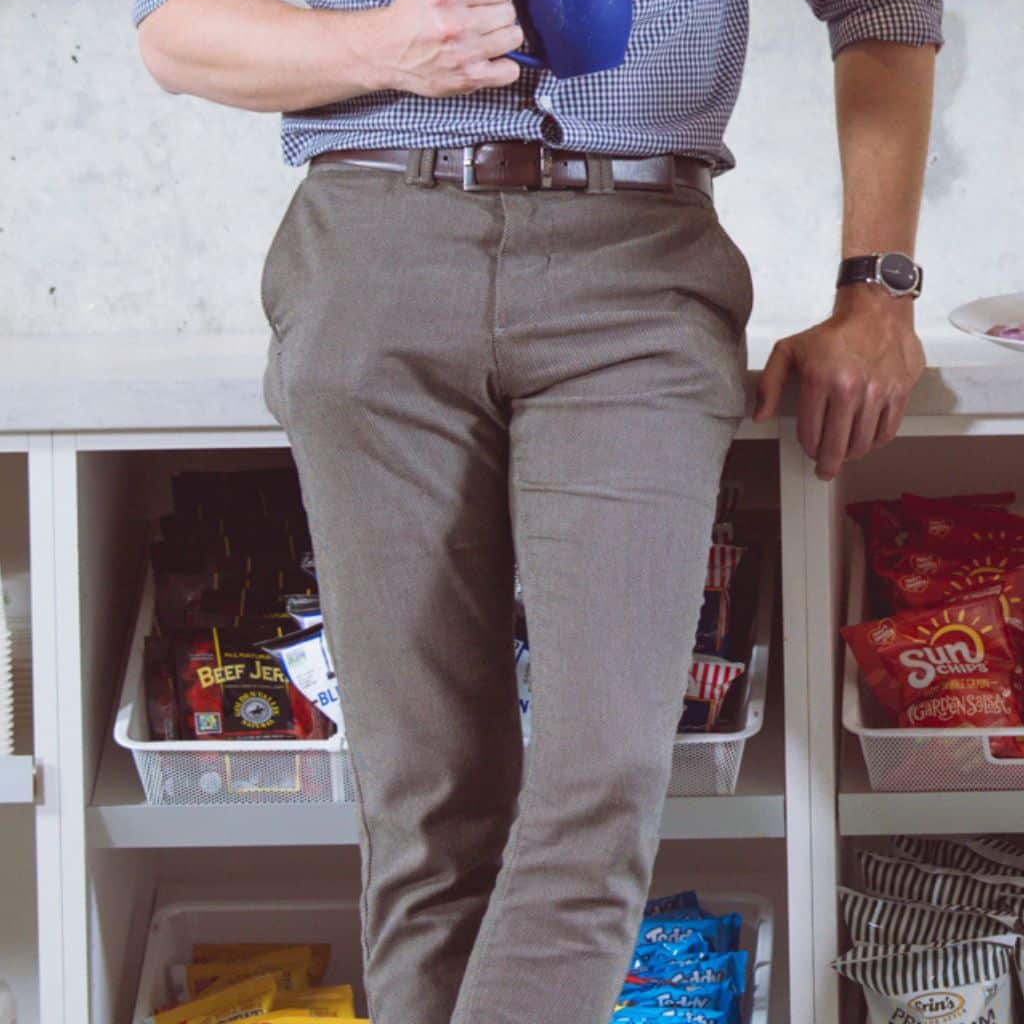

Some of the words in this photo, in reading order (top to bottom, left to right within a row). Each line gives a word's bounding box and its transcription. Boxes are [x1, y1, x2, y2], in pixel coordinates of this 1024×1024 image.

[196, 663, 246, 689] BEEF
[249, 661, 288, 683] JER
[900, 640, 984, 689] Sun
[936, 663, 989, 675] CHIPS
[645, 927, 694, 943] Todd
